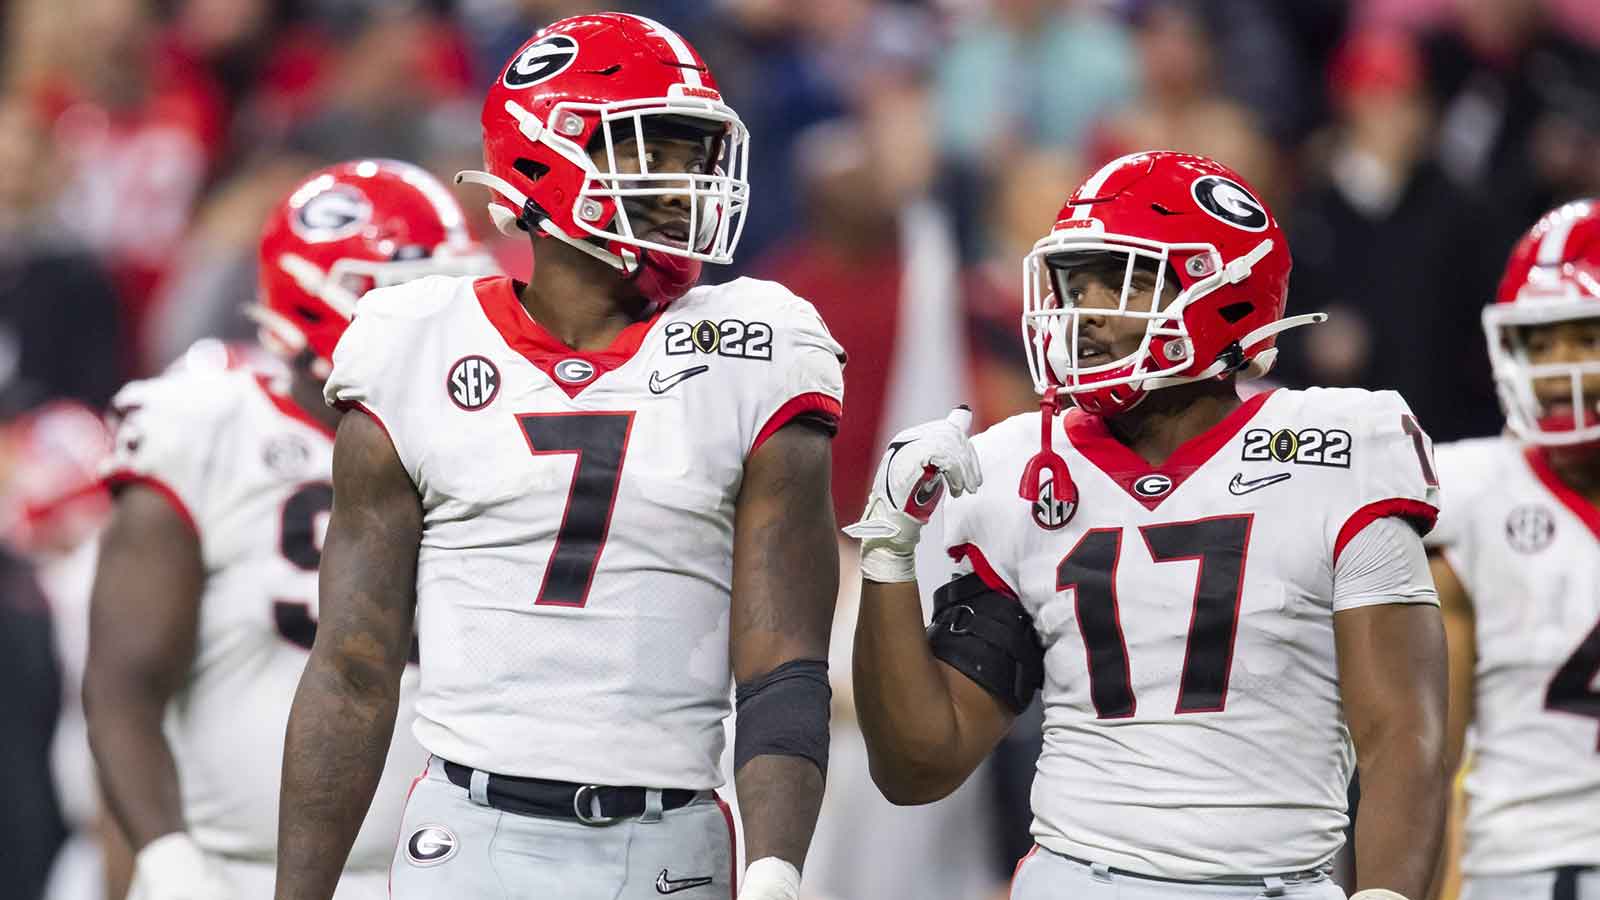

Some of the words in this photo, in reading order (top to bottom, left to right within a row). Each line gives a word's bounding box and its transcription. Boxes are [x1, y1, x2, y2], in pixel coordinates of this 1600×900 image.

[665, 319, 773, 361] 2022
[451, 359, 496, 407] SEC
[1241, 428, 1352, 469] 2022
[513, 410, 637, 608] 7
[1056, 512, 1255, 719] 17
